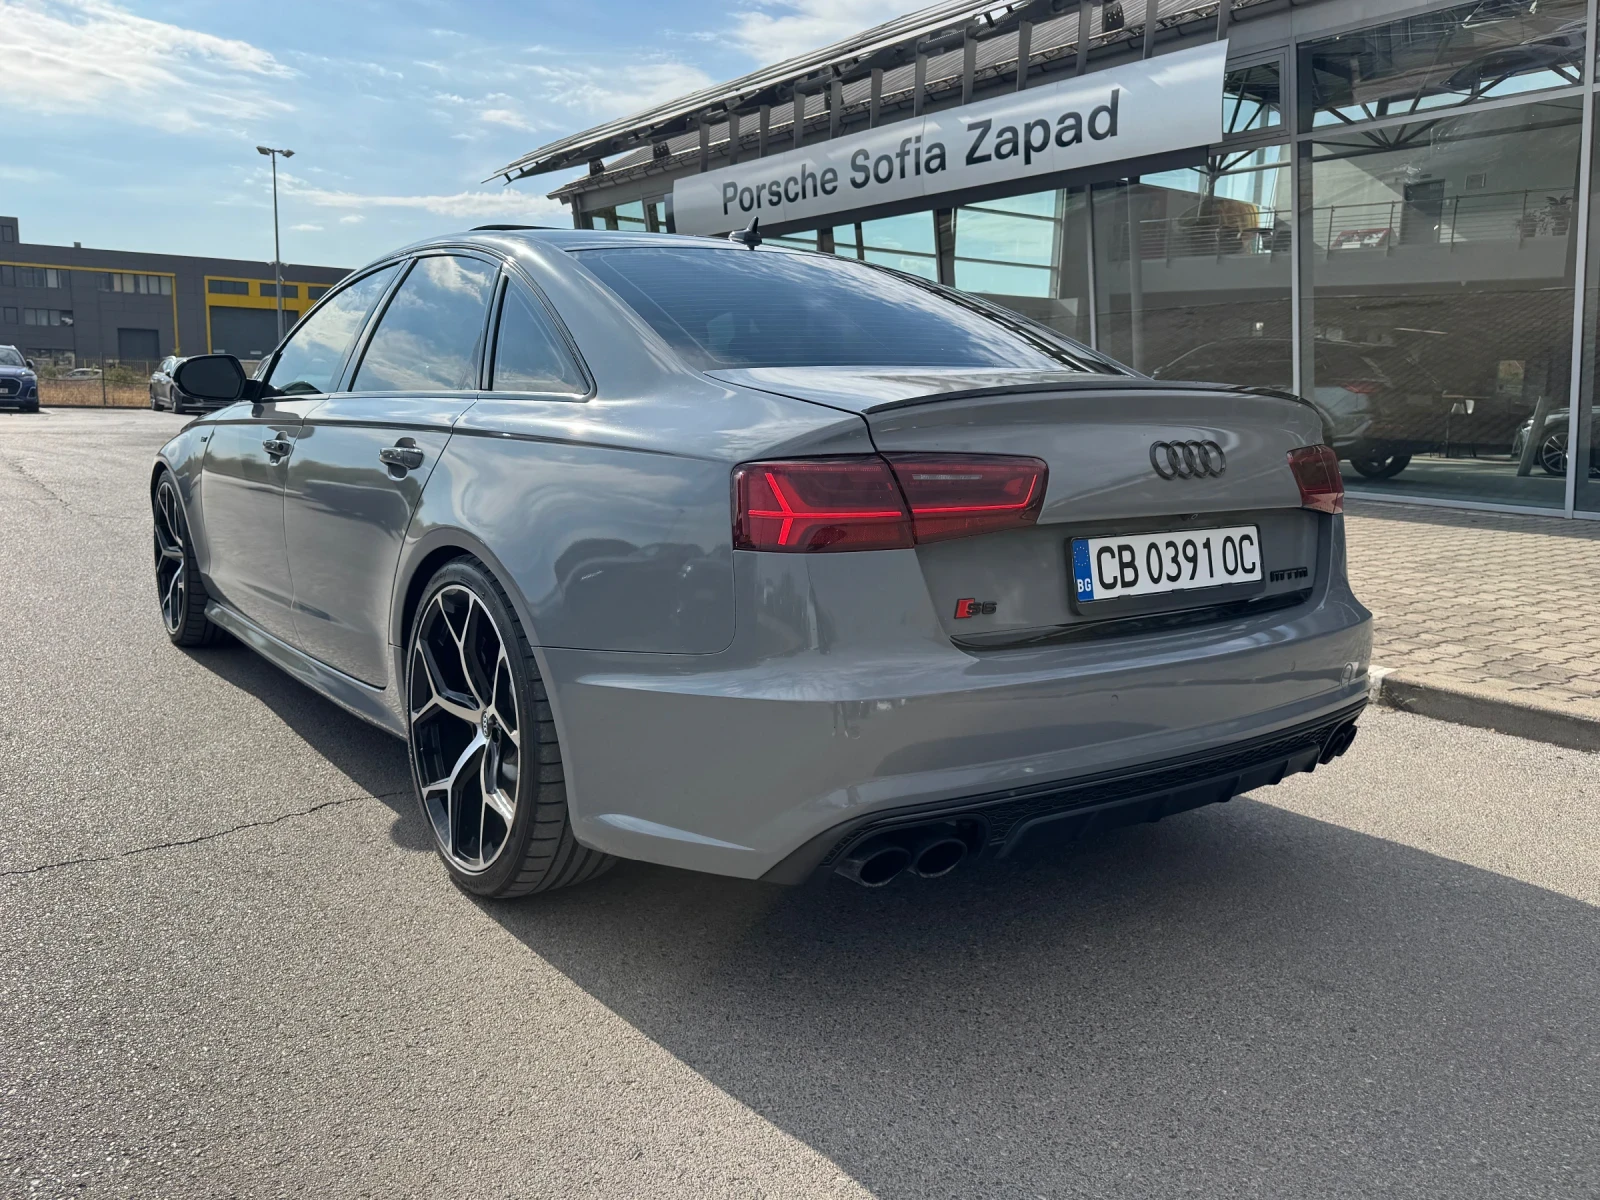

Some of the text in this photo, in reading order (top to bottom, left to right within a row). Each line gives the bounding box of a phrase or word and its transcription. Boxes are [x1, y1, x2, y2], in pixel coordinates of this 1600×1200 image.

[722, 88, 1120, 216] Porsche Sofia Zapad
[1096, 544, 1140, 590] CB
[1145, 537, 1214, 585] 0391
[1076, 578, 1092, 592] BG
[965, 600, 998, 616] S6
